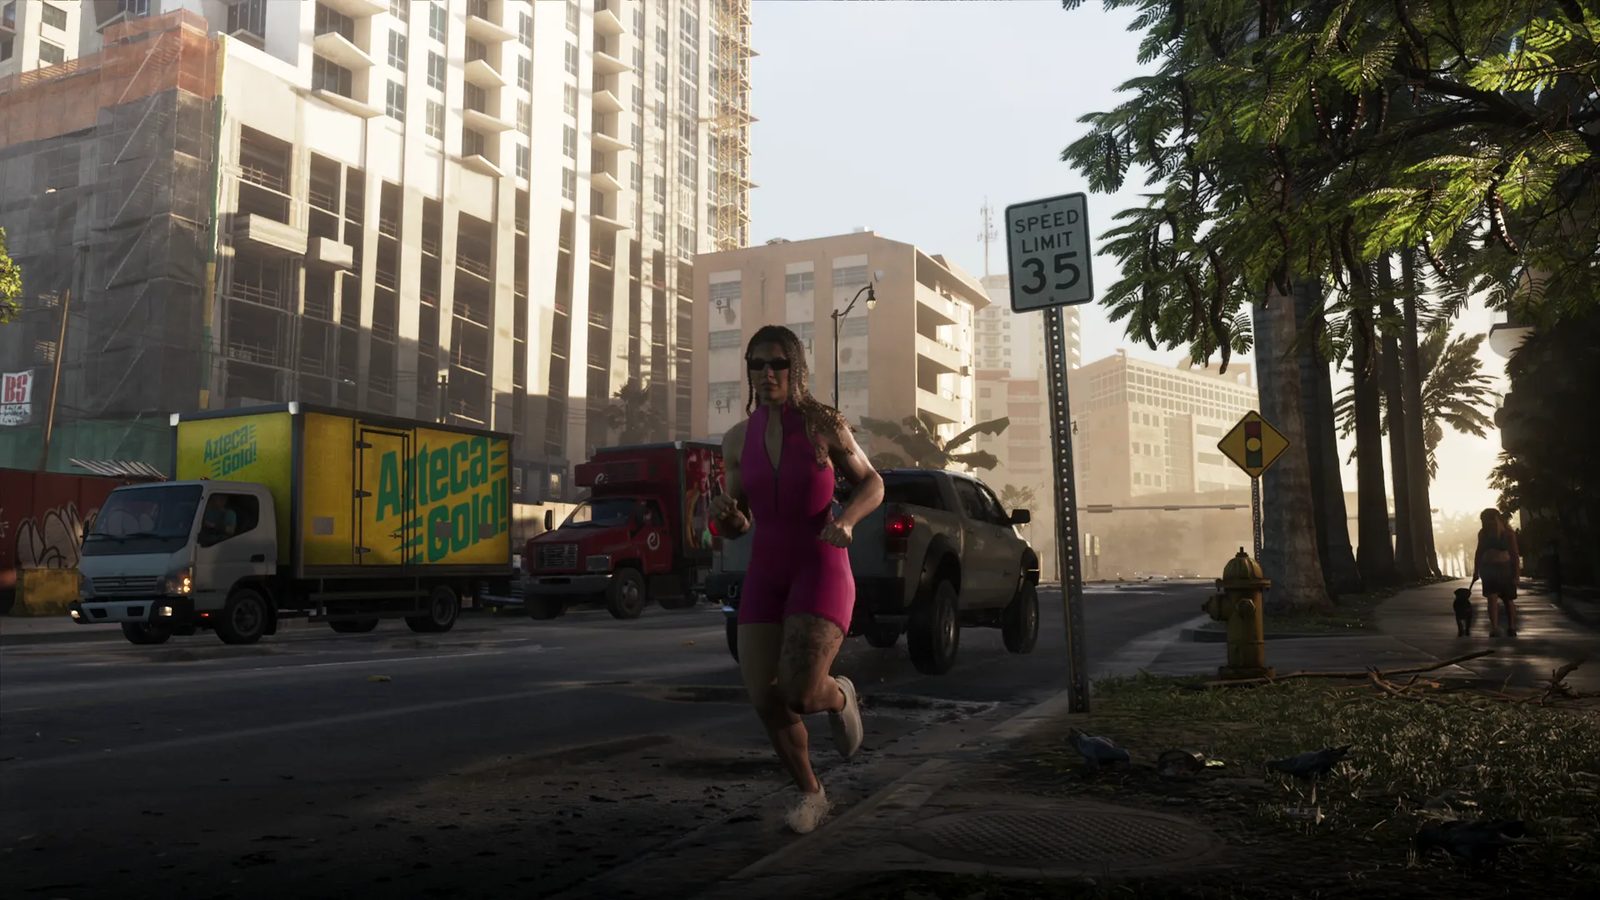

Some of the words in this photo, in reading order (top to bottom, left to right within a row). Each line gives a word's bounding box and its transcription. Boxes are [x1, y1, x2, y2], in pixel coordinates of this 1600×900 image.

[1014, 209, 1079, 233] SPEED
[1022, 231, 1072, 253] LIMIT
[1022, 251, 1080, 295] 35
[4, 374, 28, 402] BS
[203, 424, 249, 464] Azteca
[223, 440, 256, 476] Gold!
[427, 477, 507, 563] Gold!
